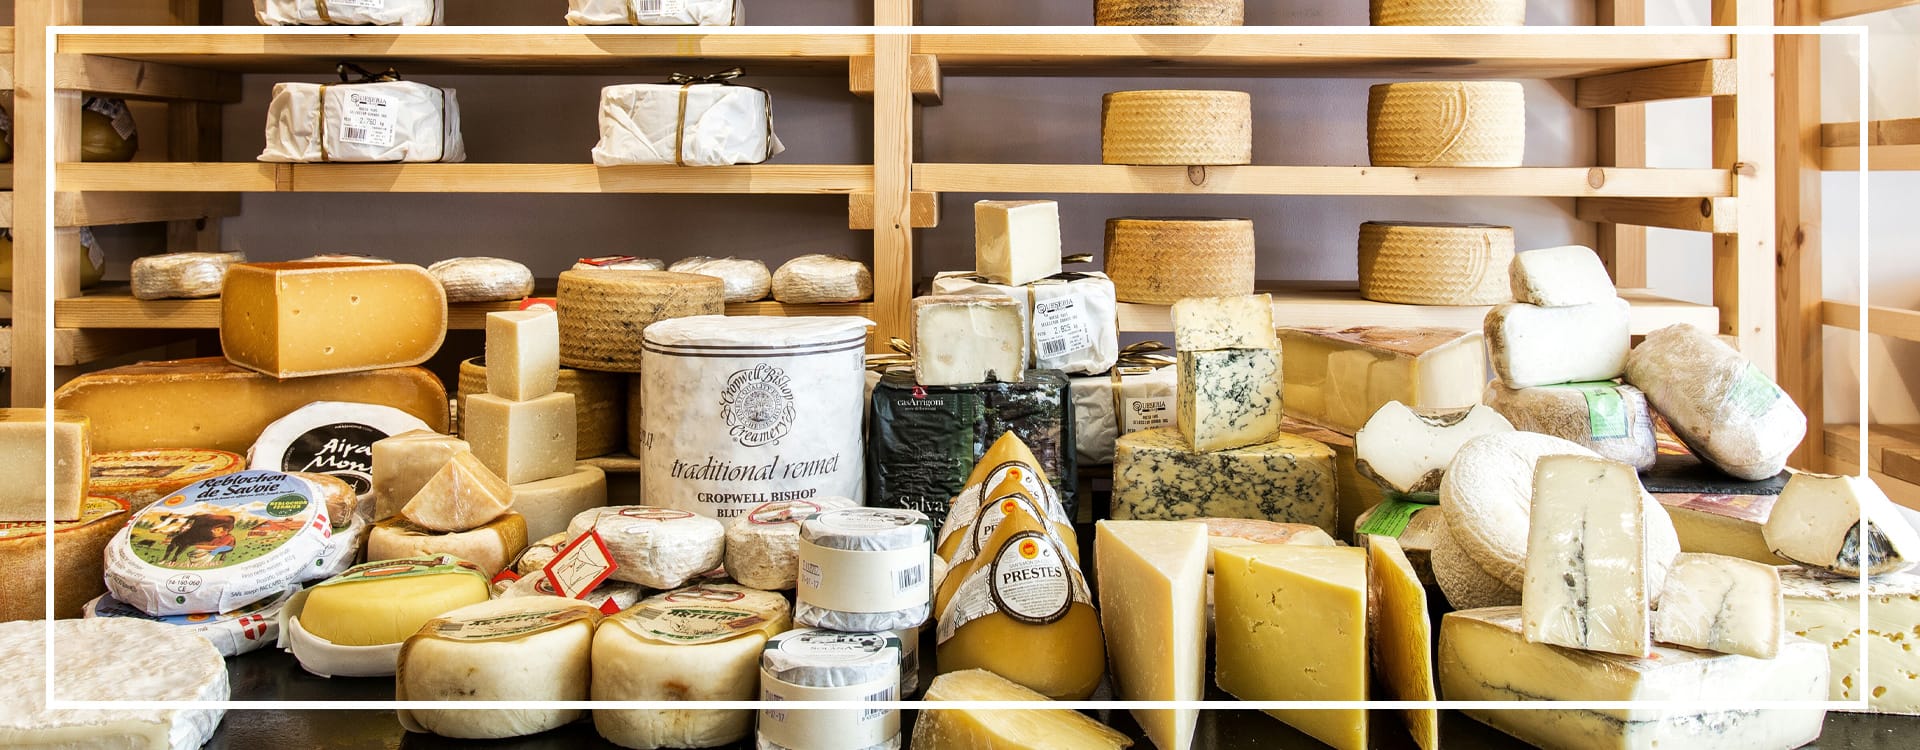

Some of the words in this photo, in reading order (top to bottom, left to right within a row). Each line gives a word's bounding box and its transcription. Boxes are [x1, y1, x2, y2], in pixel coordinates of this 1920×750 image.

[719, 364, 764, 406] Cropwell
[761, 365, 794, 401] Bishop
[897, 397, 944, 408] casArrigoni
[729, 412, 794, 446] Creamery
[670, 455, 780, 482] traditional
[783, 453, 840, 480] rennet
[198, 471, 287, 488] Reblochon
[197, 486, 220, 498] de
[222, 481, 280, 496] Savoie
[697, 491, 767, 504] CROPWELL
[771, 488, 817, 502] BISHOP
[900, 495, 945, 512] Salva
[1003, 566, 1062, 584] PRESTES
